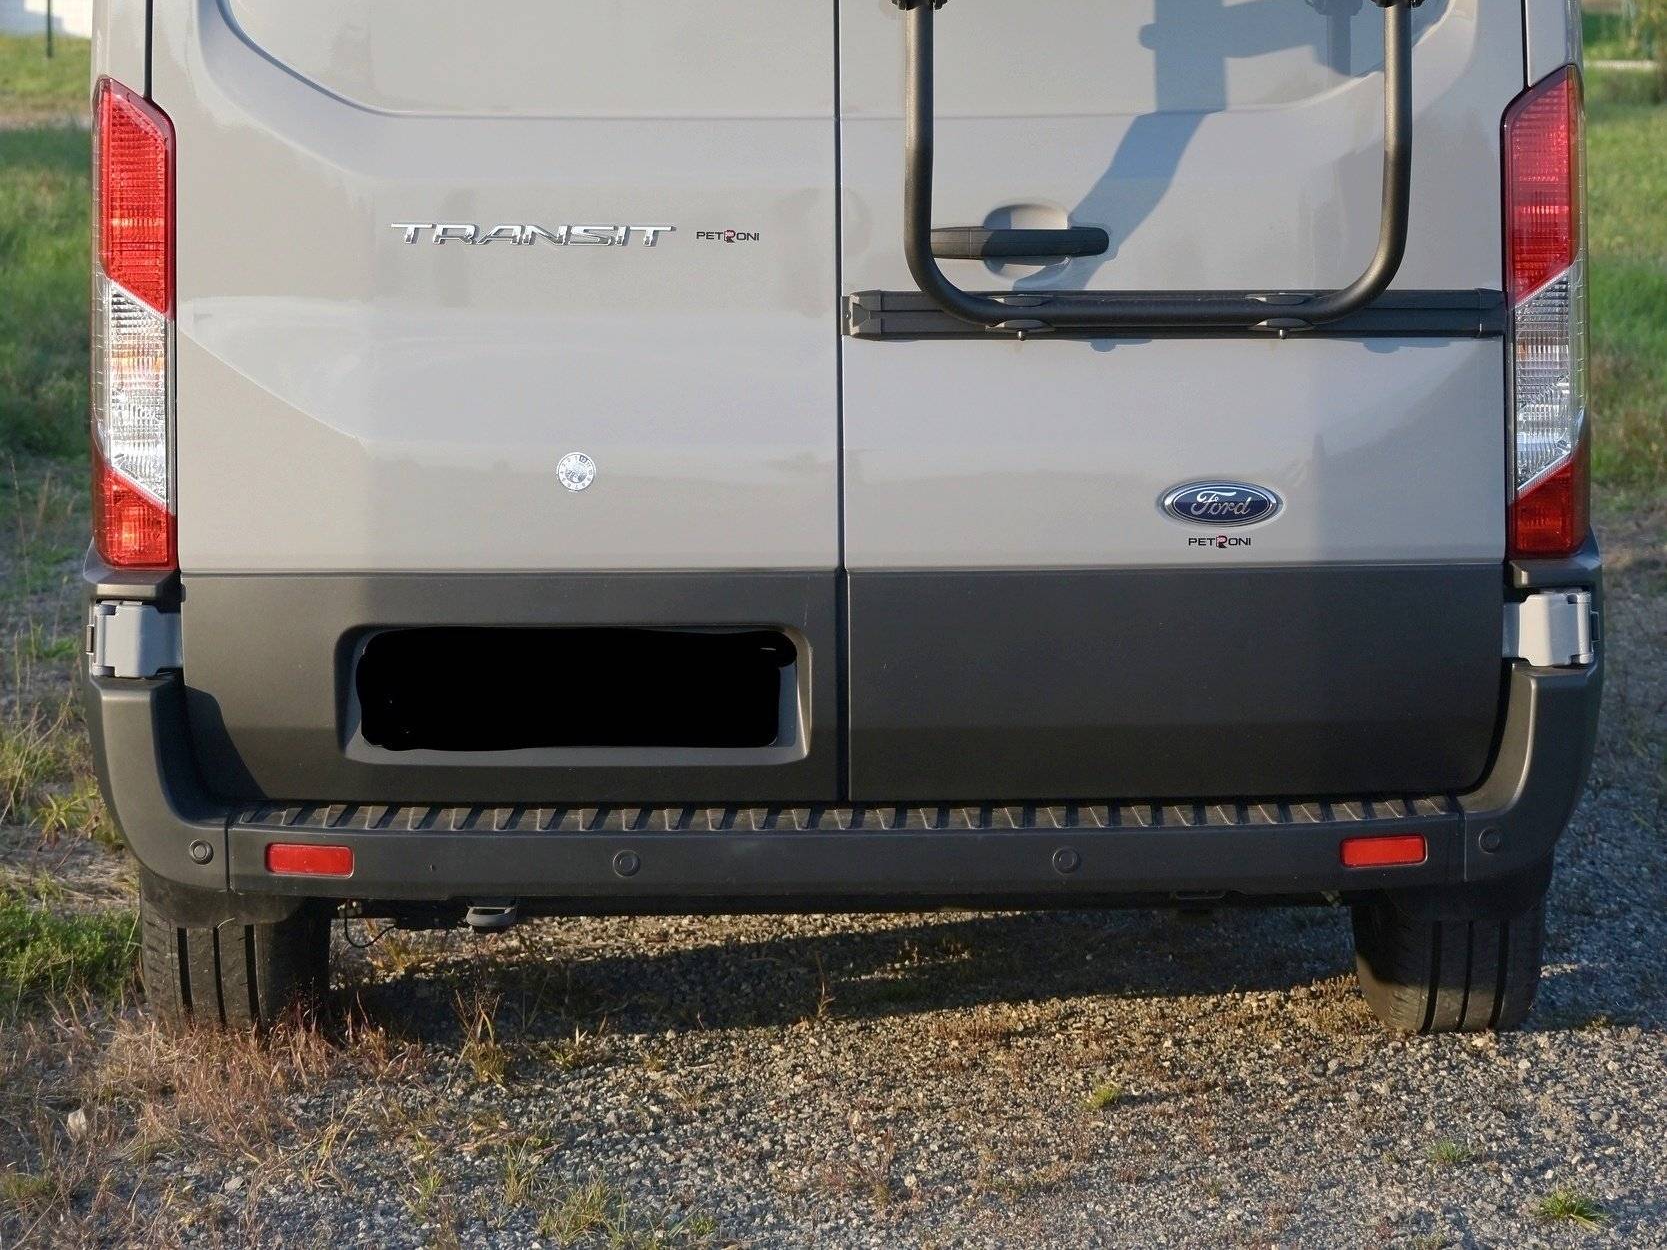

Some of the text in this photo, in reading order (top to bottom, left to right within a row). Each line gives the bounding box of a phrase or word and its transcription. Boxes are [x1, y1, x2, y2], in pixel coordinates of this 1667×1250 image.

[391, 223, 676, 247] TRANSIT
[696, 230, 760, 244] PETRONI
[1190, 490, 1252, 516] Ford
[1188, 535, 1252, 549] PETRONI
